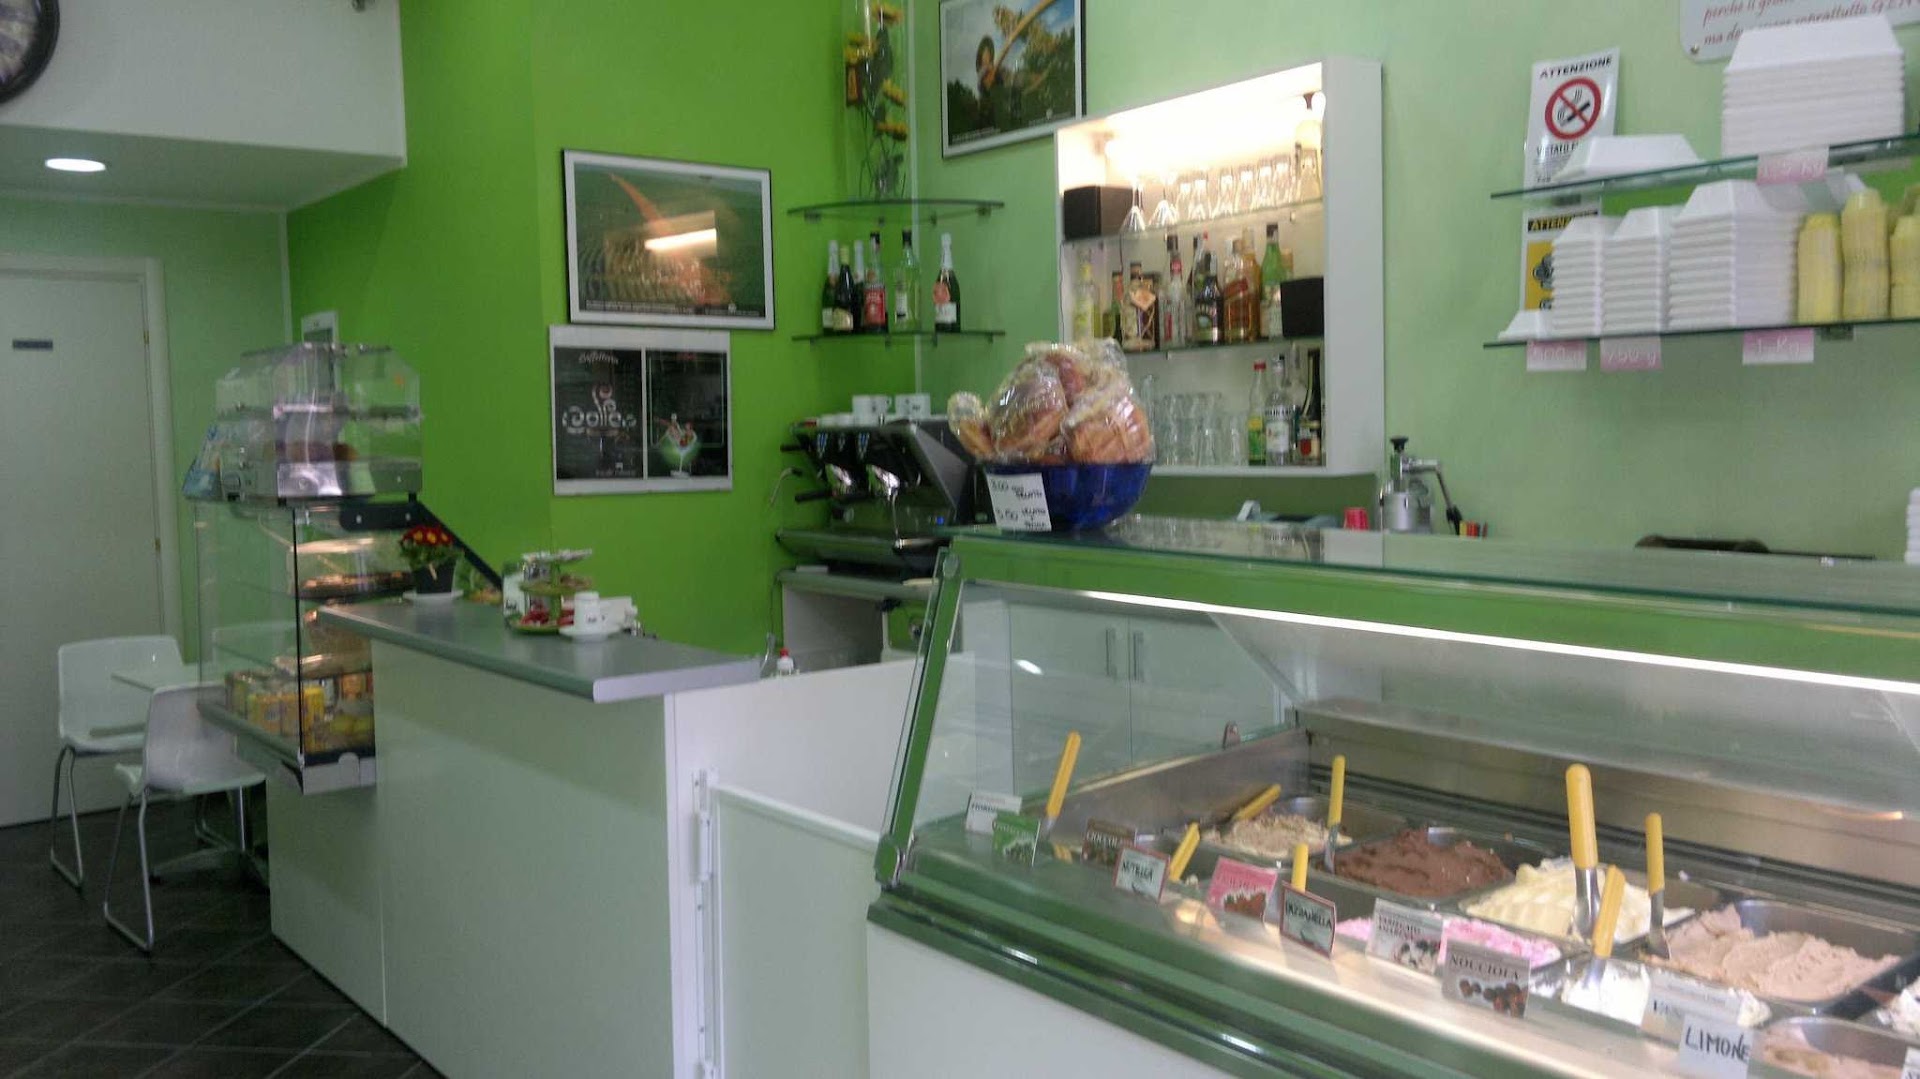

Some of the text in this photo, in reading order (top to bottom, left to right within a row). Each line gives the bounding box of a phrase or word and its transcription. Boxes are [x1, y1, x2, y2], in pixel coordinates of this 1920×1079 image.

[1540, 55, 1612, 78] ATTENZIONE
[1452, 954, 1519, 980] NOCCIOLA
[1684, 1026, 1751, 1065] LIMONE
